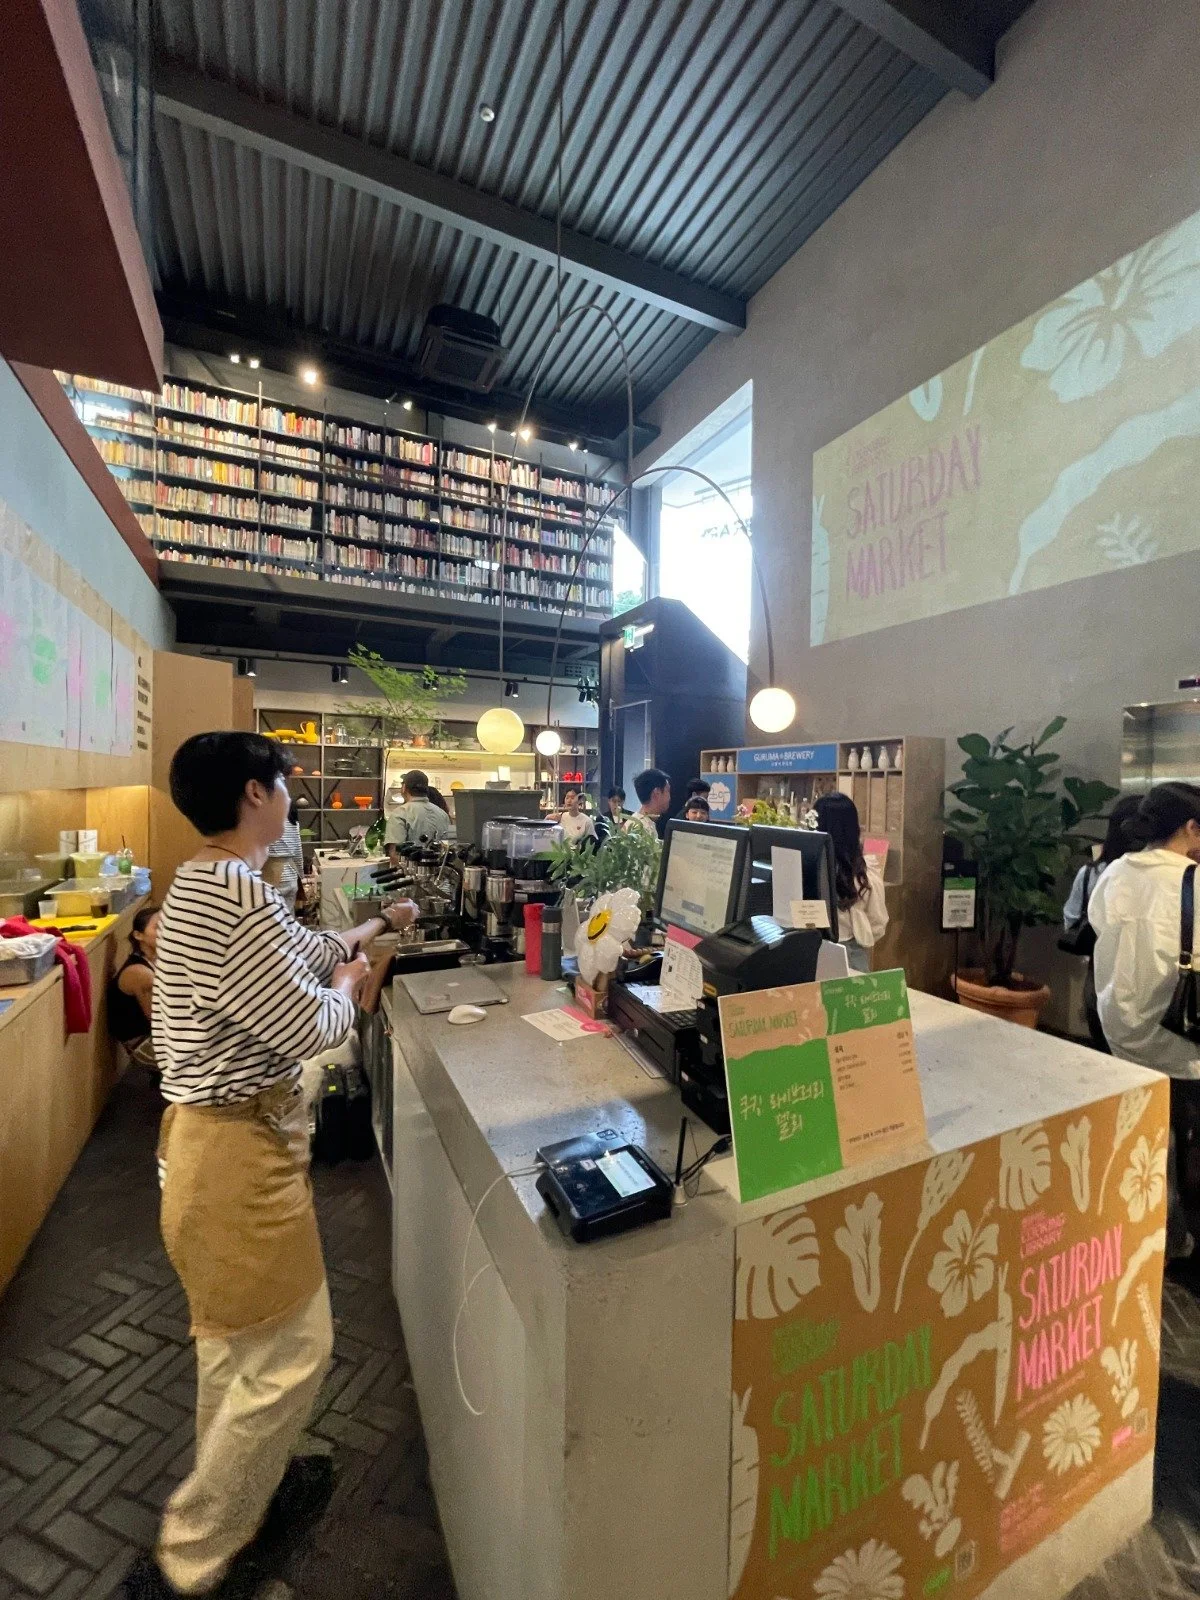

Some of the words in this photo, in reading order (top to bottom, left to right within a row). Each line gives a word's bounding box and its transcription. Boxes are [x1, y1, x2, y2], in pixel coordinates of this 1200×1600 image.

[847, 424, 981, 539] SATURDAY
[846, 510, 949, 602] MARKET
[753, 751, 780, 762] GURUMA
[783, 750, 815, 761] BREWERY
[1019, 1223, 1123, 1330] SATURDAY
[769, 1323, 933, 1469] SATURDAY
[1016, 1293, 1103, 1402] MARKET
[769, 1412, 904, 1560] MARKET
